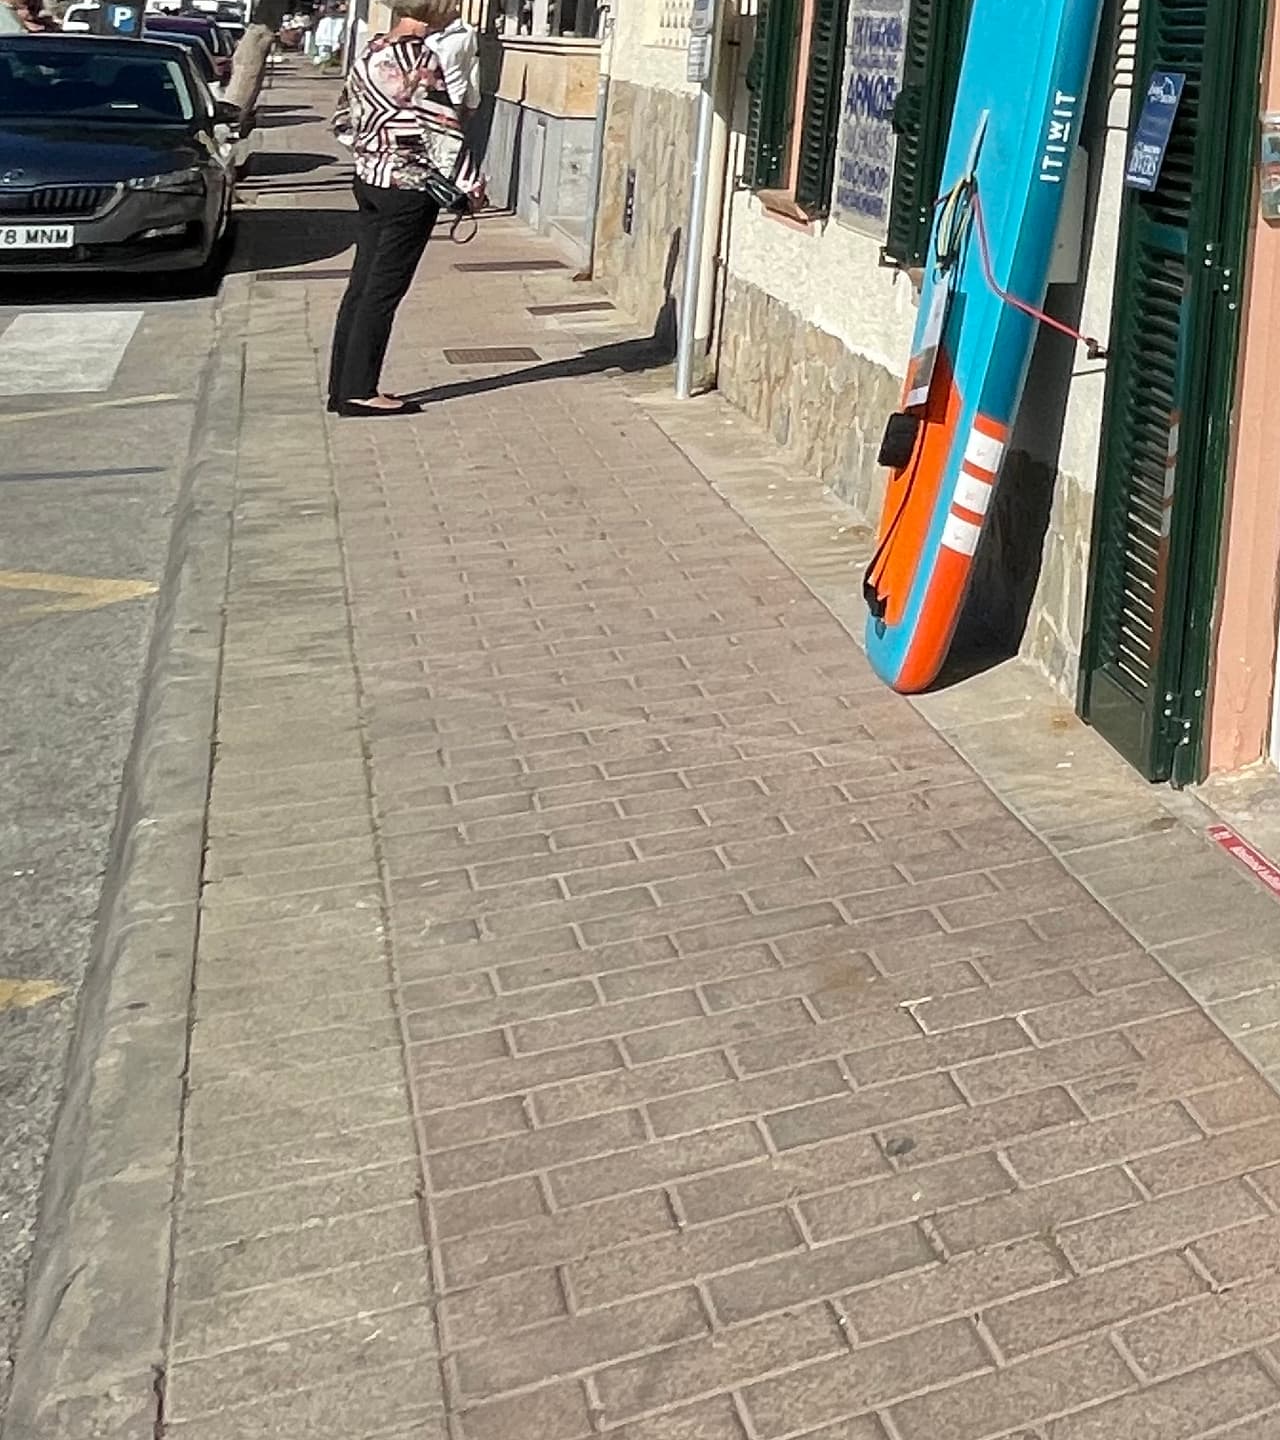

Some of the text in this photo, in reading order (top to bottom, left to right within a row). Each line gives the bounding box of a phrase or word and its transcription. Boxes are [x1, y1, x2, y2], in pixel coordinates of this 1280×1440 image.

[113, 6, 132, 28] P
[1039, 89, 1076, 183] ITIWIT
[0, 229, 68, 245] 8 MNM
